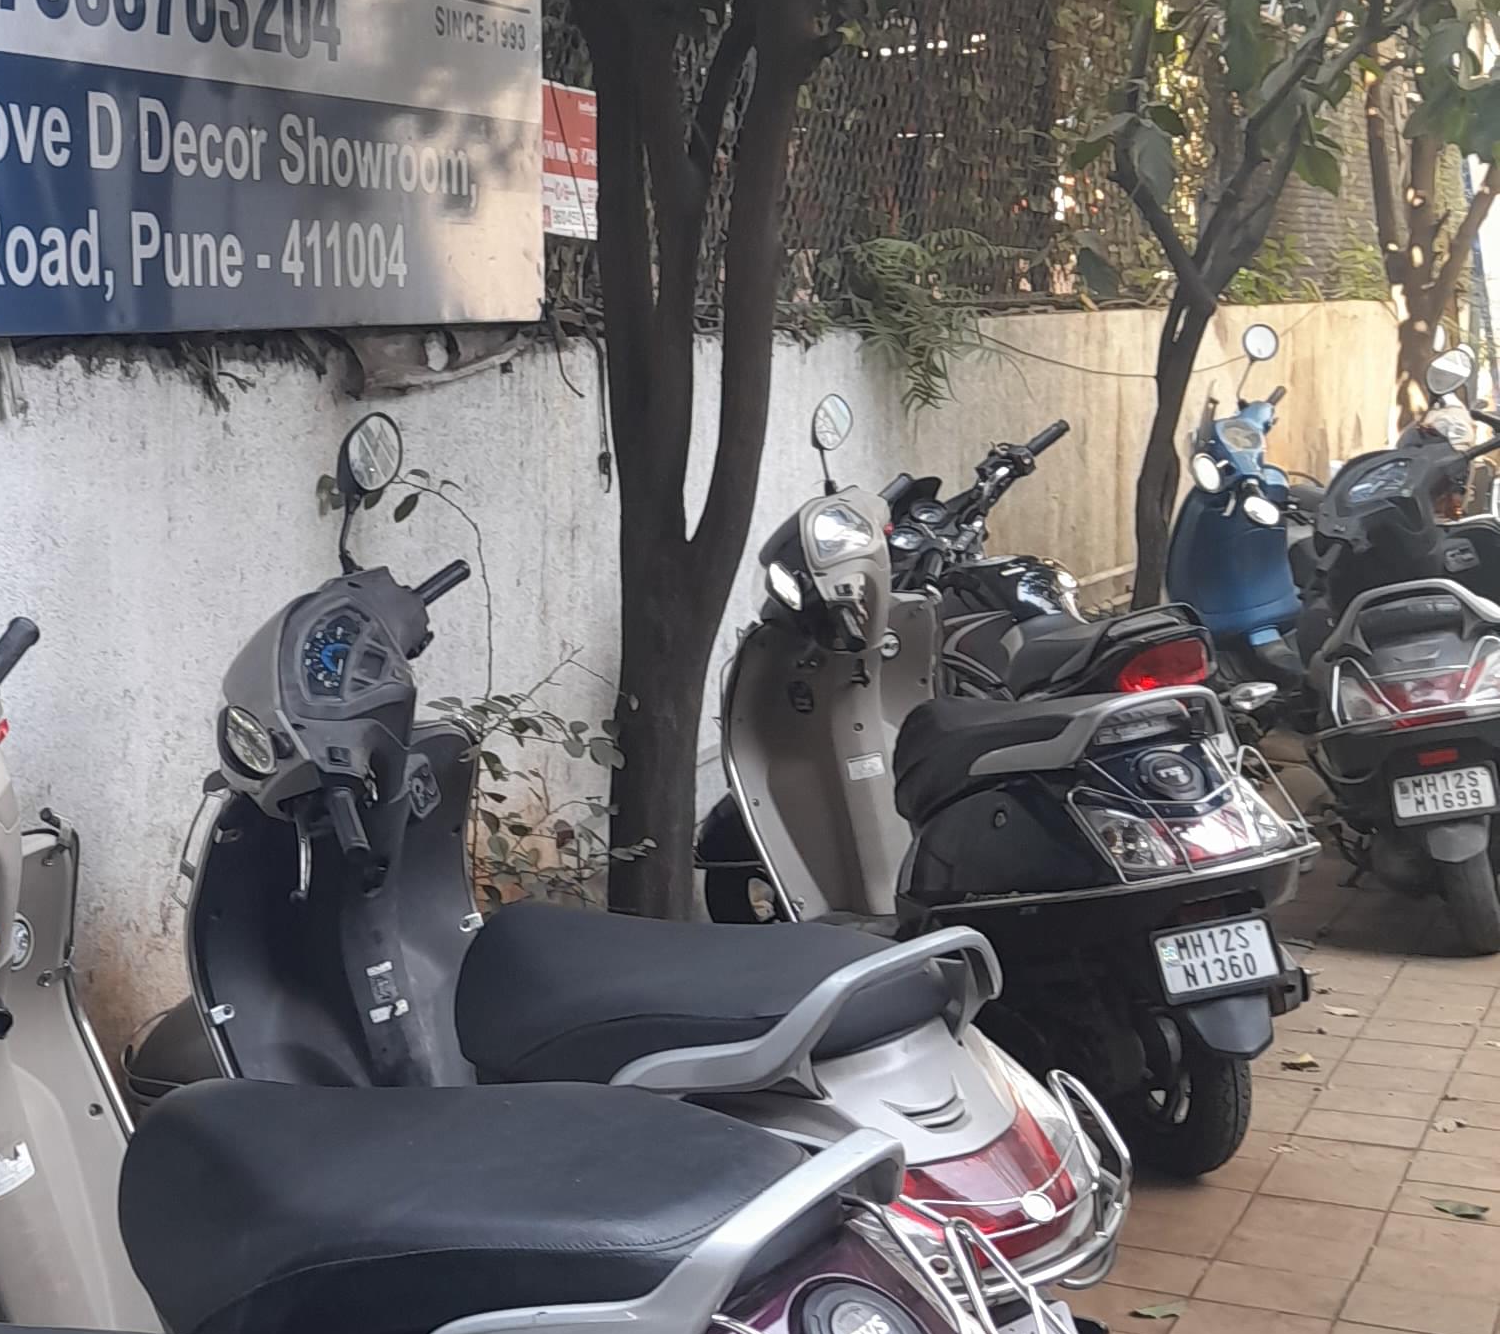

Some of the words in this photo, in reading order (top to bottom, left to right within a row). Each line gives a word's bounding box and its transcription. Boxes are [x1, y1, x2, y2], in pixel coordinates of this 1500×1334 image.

[434, 5, 527, 52] SINCE-1993
[88, 91, 122, 169] D
[137, 97, 268, 182] Decor
[278, 120, 478, 209] Showroom,
[130, 211, 243, 288] Pune
[282, 221, 408, 289] 411004
[1174, 925, 1250, 961] MH12S
[1182, 952, 1258, 988] N1360
